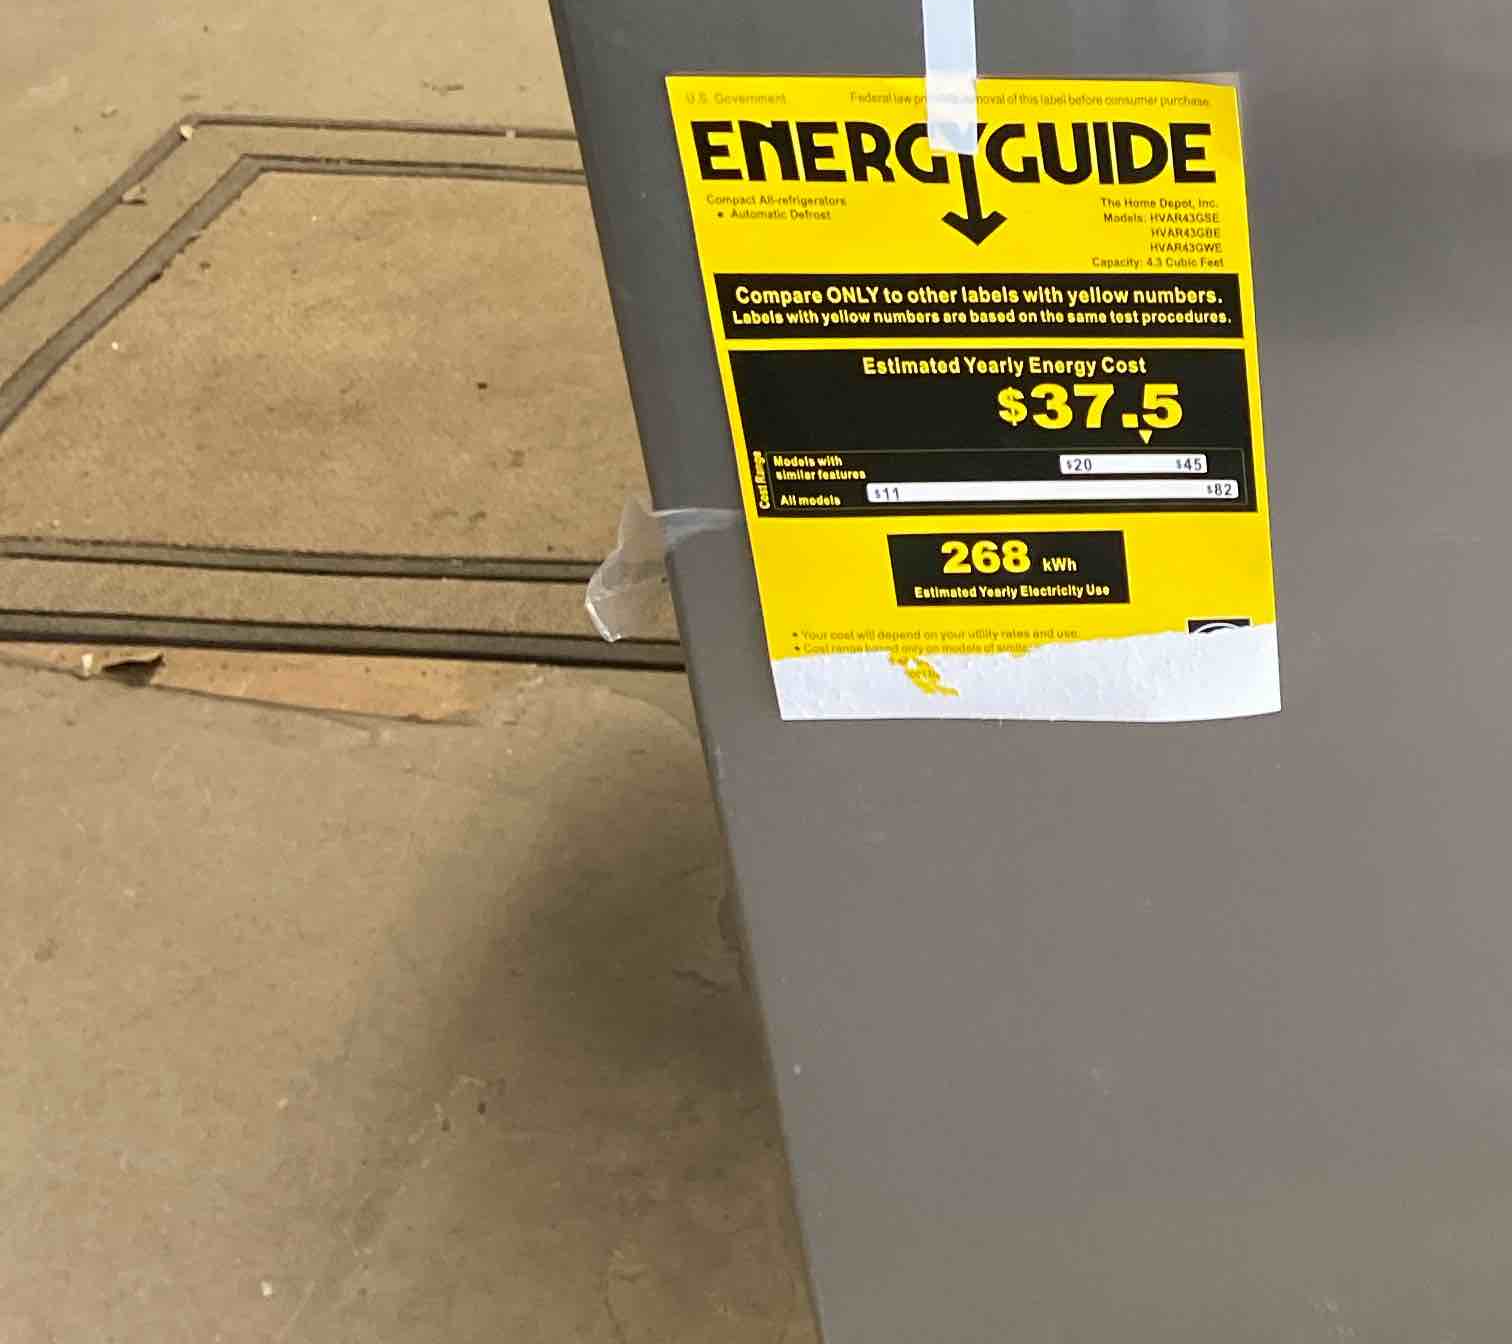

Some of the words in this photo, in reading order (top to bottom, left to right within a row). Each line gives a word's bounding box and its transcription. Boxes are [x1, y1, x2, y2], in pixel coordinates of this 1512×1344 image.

[685, 93, 708, 105] U.S.
[714, 93, 787, 105] Government
[850, 92, 890, 104] Federal
[892, 93, 912, 104] law
[1008, 94, 1018, 105] of
[1019, 94, 1038, 105] this
[1041, 94, 1066, 105] label
[1069, 94, 1102, 106] before
[1105, 96, 1157, 106] consumer
[707, 195, 756, 206] Compact
[760, 195, 848, 208] All-refrigerators
[1101, 197, 1121, 208] The
[1125, 197, 1156, 208] Home
[1160, 198, 1195, 210] Depot,
[1198, 198, 1219, 208] Inc.
[731, 210, 787, 220] Automatic
[791, 210, 831, 220] Defrost
[1104, 213, 1146, 223] Models:
[1092, 257, 1142, 268] Capacity:
[1147, 257, 1162, 267] 4.3
[1166, 257, 1197, 267] Cubic
[1200, 257, 1225, 267] Feet
[736, 286, 823, 307] Compare
[826, 286, 879, 304] ONLY
[883, 287, 903, 304] to
[907, 286, 957, 304] other
[961, 286, 1019, 304] labels
[1023, 286, 1063, 303] with
[1067, 286, 1128, 307] yellow
[1133, 286, 1223, 304] numbers.
[732, 309, 784, 324] Labels
[786, 309, 819, 324] with
[821, 309, 871, 327] yellow
[873, 309, 939, 324] numbers
[943, 311, 967, 324] are
[969, 309, 1015, 323] based
[1019, 310, 1038, 323] on
[1040, 309, 1063, 323] the
[1067, 311, 1107, 323] same
[1110, 310, 1139, 323] test
[1141, 309, 1232, 326] procedures.
[862, 356, 961, 375] Estimated
[964, 356, 1024, 377] Yearly
[1029, 356, 1097, 377] Energy
[1101, 356, 1147, 374] Cost
[997, 383, 1183, 429] $37.5
[773, 455, 815, 467] Models
[818, 455, 843, 467] with
[1066, 458, 1093, 471] $20
[1176, 457, 1202, 471] $45
[776, 469, 815, 481] similar
[818, 469, 866, 481] features
[875, 487, 899, 501] $11
[1206, 482, 1232, 496] $82
[757, 485, 770, 509] Cost
[780, 495, 796, 506] All
[798, 495, 841, 506] models
[940, 540, 1031, 574] 268
[1042, 557, 1077, 572] kWh
[914, 586, 977, 599] Estimated
[979, 586, 1018, 600] Yearly
[1020, 584, 1083, 599] Electricity
[1086, 584, 1110, 596] Use
[801, 630, 827, 641] Your
[830, 630, 855, 640] cost
[857, 629, 875, 640] will
[877, 629, 921, 642] depend
[924, 631, 938, 640] on
[940, 631, 965, 642] your
[968, 629, 999, 641] utility
[1001, 629, 1030, 639] rates
[1033, 628, 1054, 639] and
